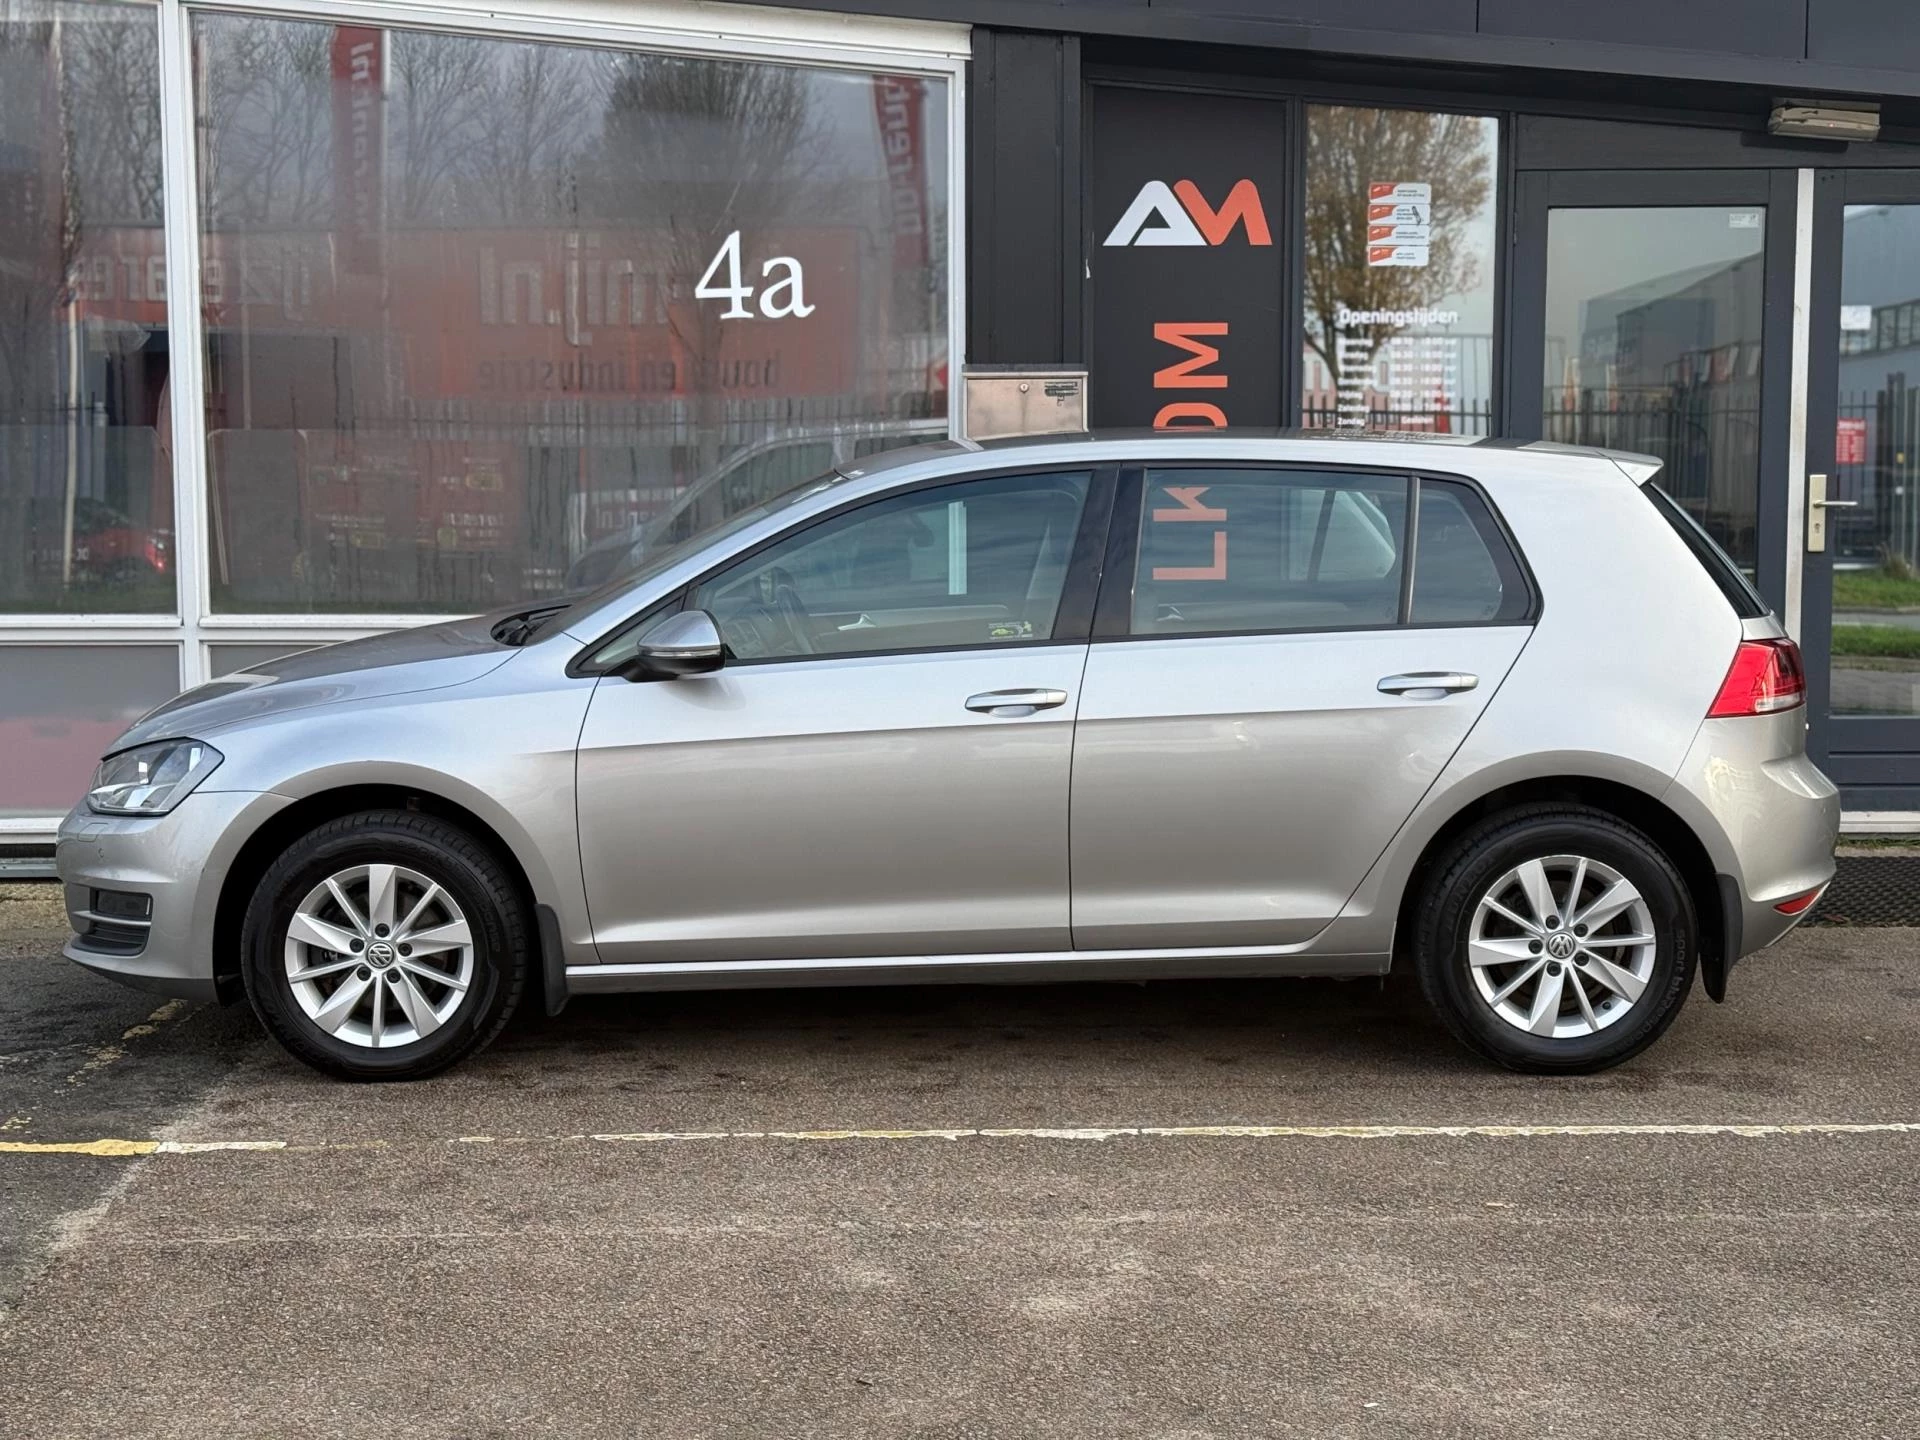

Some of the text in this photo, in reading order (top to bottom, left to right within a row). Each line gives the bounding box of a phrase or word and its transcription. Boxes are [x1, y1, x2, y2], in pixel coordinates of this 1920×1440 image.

[1103, 179, 1273, 247] AM
[694, 230, 815, 321] 4a
[1339, 307, 1458, 328] Openingstijden
